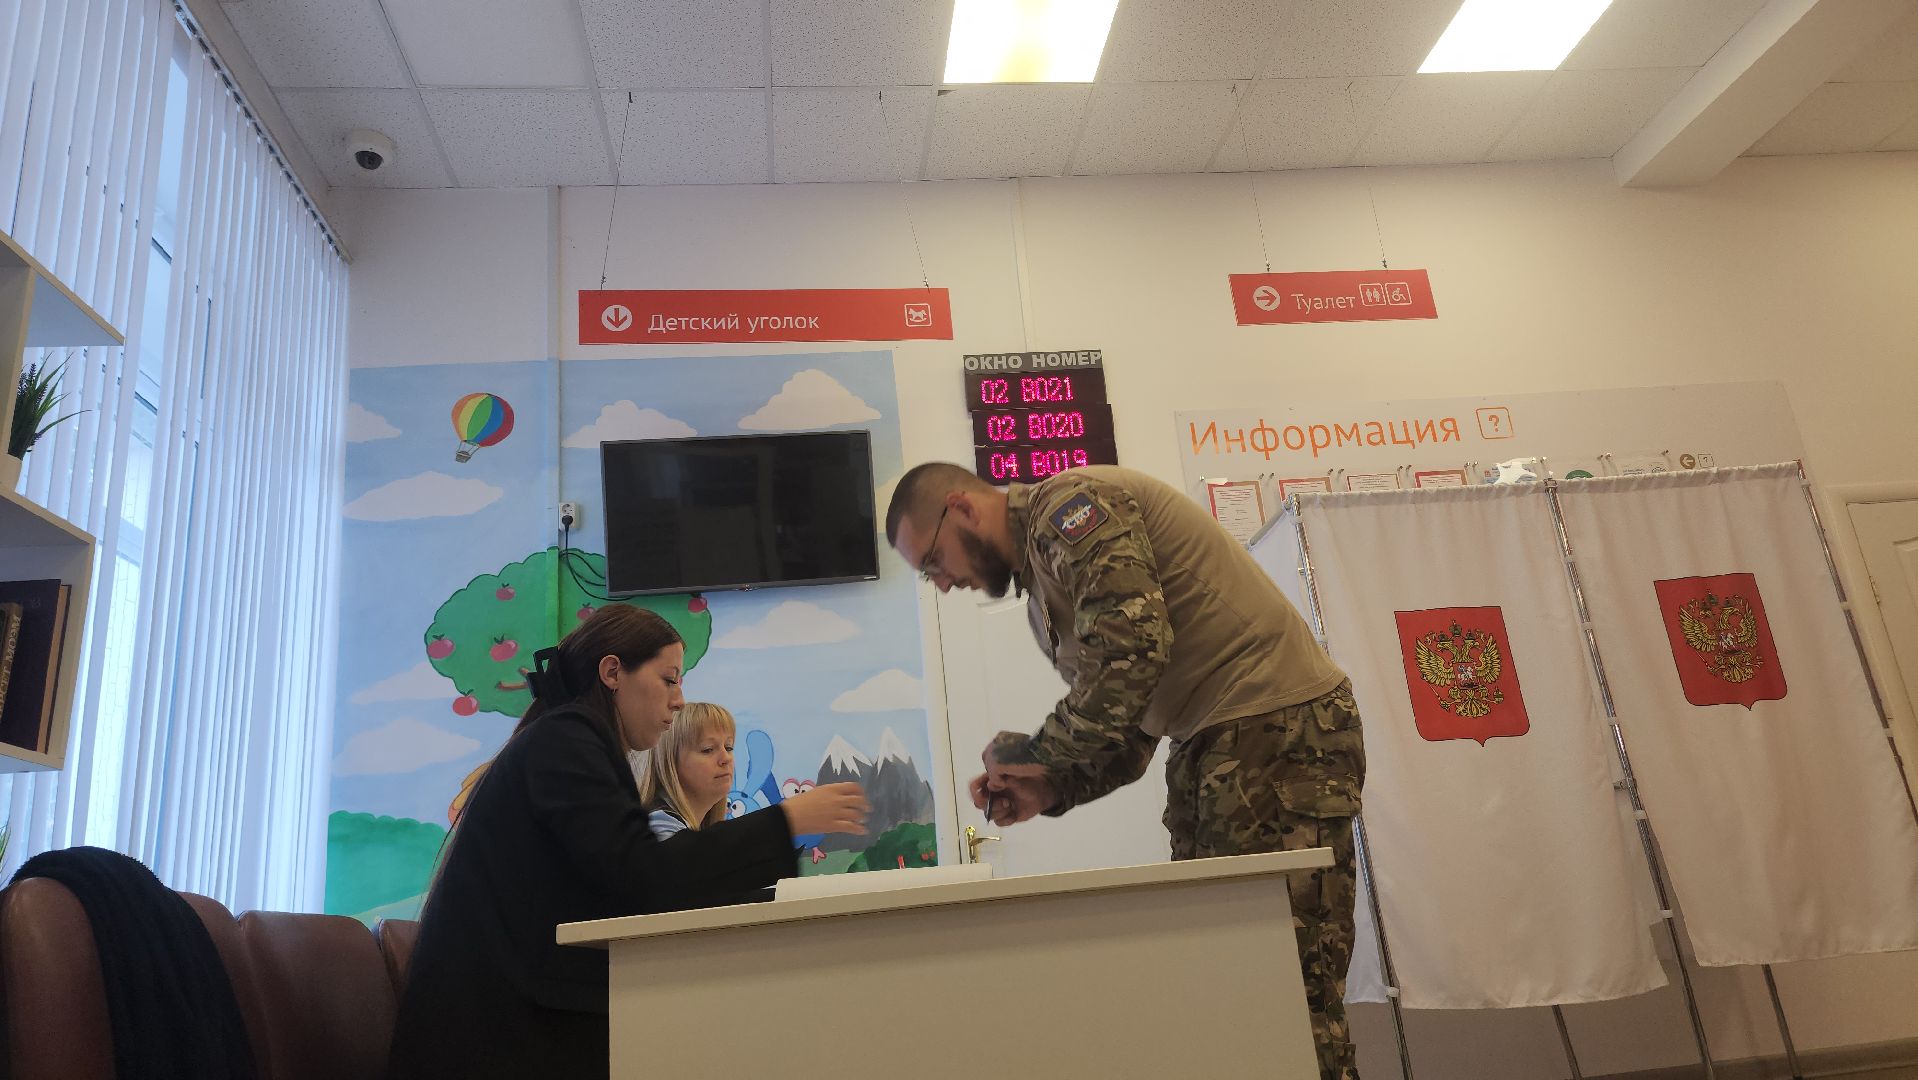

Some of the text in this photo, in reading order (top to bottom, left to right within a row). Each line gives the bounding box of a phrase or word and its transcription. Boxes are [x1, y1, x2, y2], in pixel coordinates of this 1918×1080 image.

[1291, 293, 1356, 315] Туалет
[648, 313, 820, 334] Детский уголок
[965, 351, 1102, 371] ОКНО НОМЕР
[981, 379, 1009, 404] 02
[987, 415, 1017, 441] 02
[1189, 417, 1461, 460] Информация
[991, 452, 1019, 479] 04
